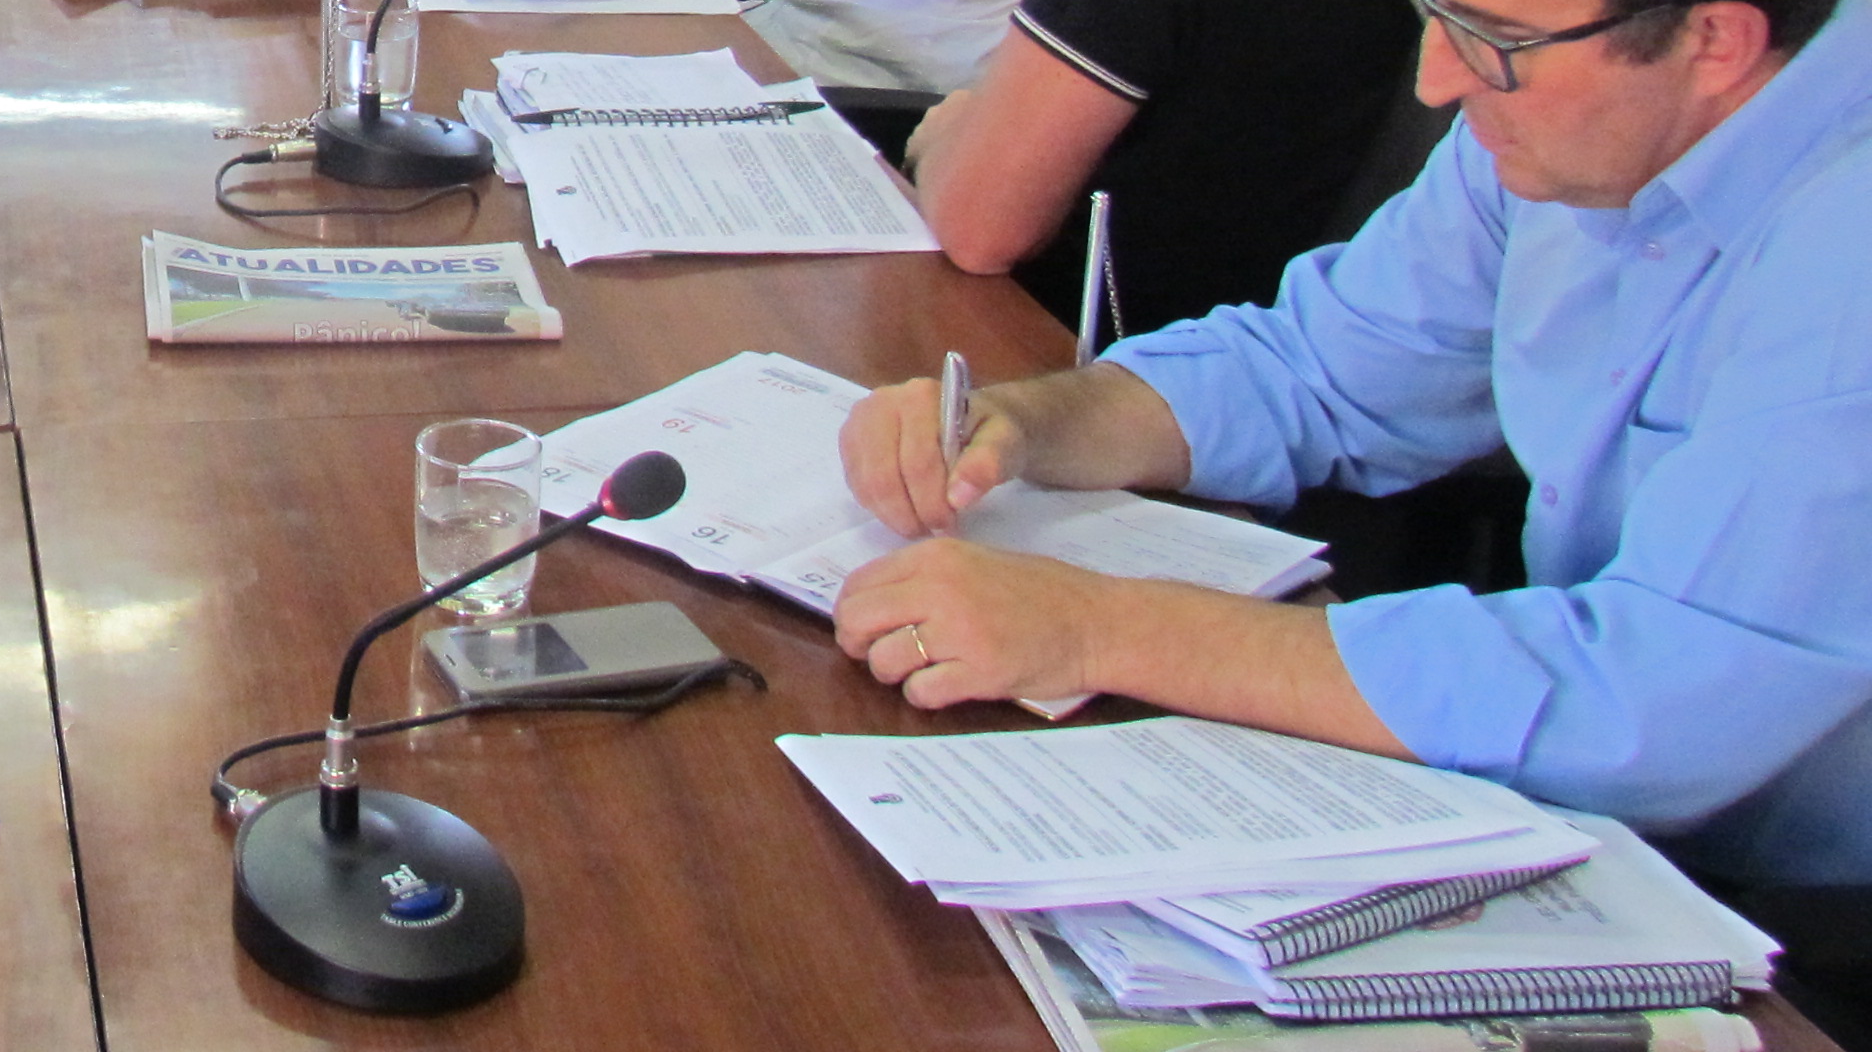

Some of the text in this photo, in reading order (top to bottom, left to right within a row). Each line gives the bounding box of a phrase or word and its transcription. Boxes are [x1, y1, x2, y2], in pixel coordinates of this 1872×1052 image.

[178, 247, 501, 274] ATUALIDADES
[661, 417, 696, 434] 19
[691, 525, 732, 546] 16
